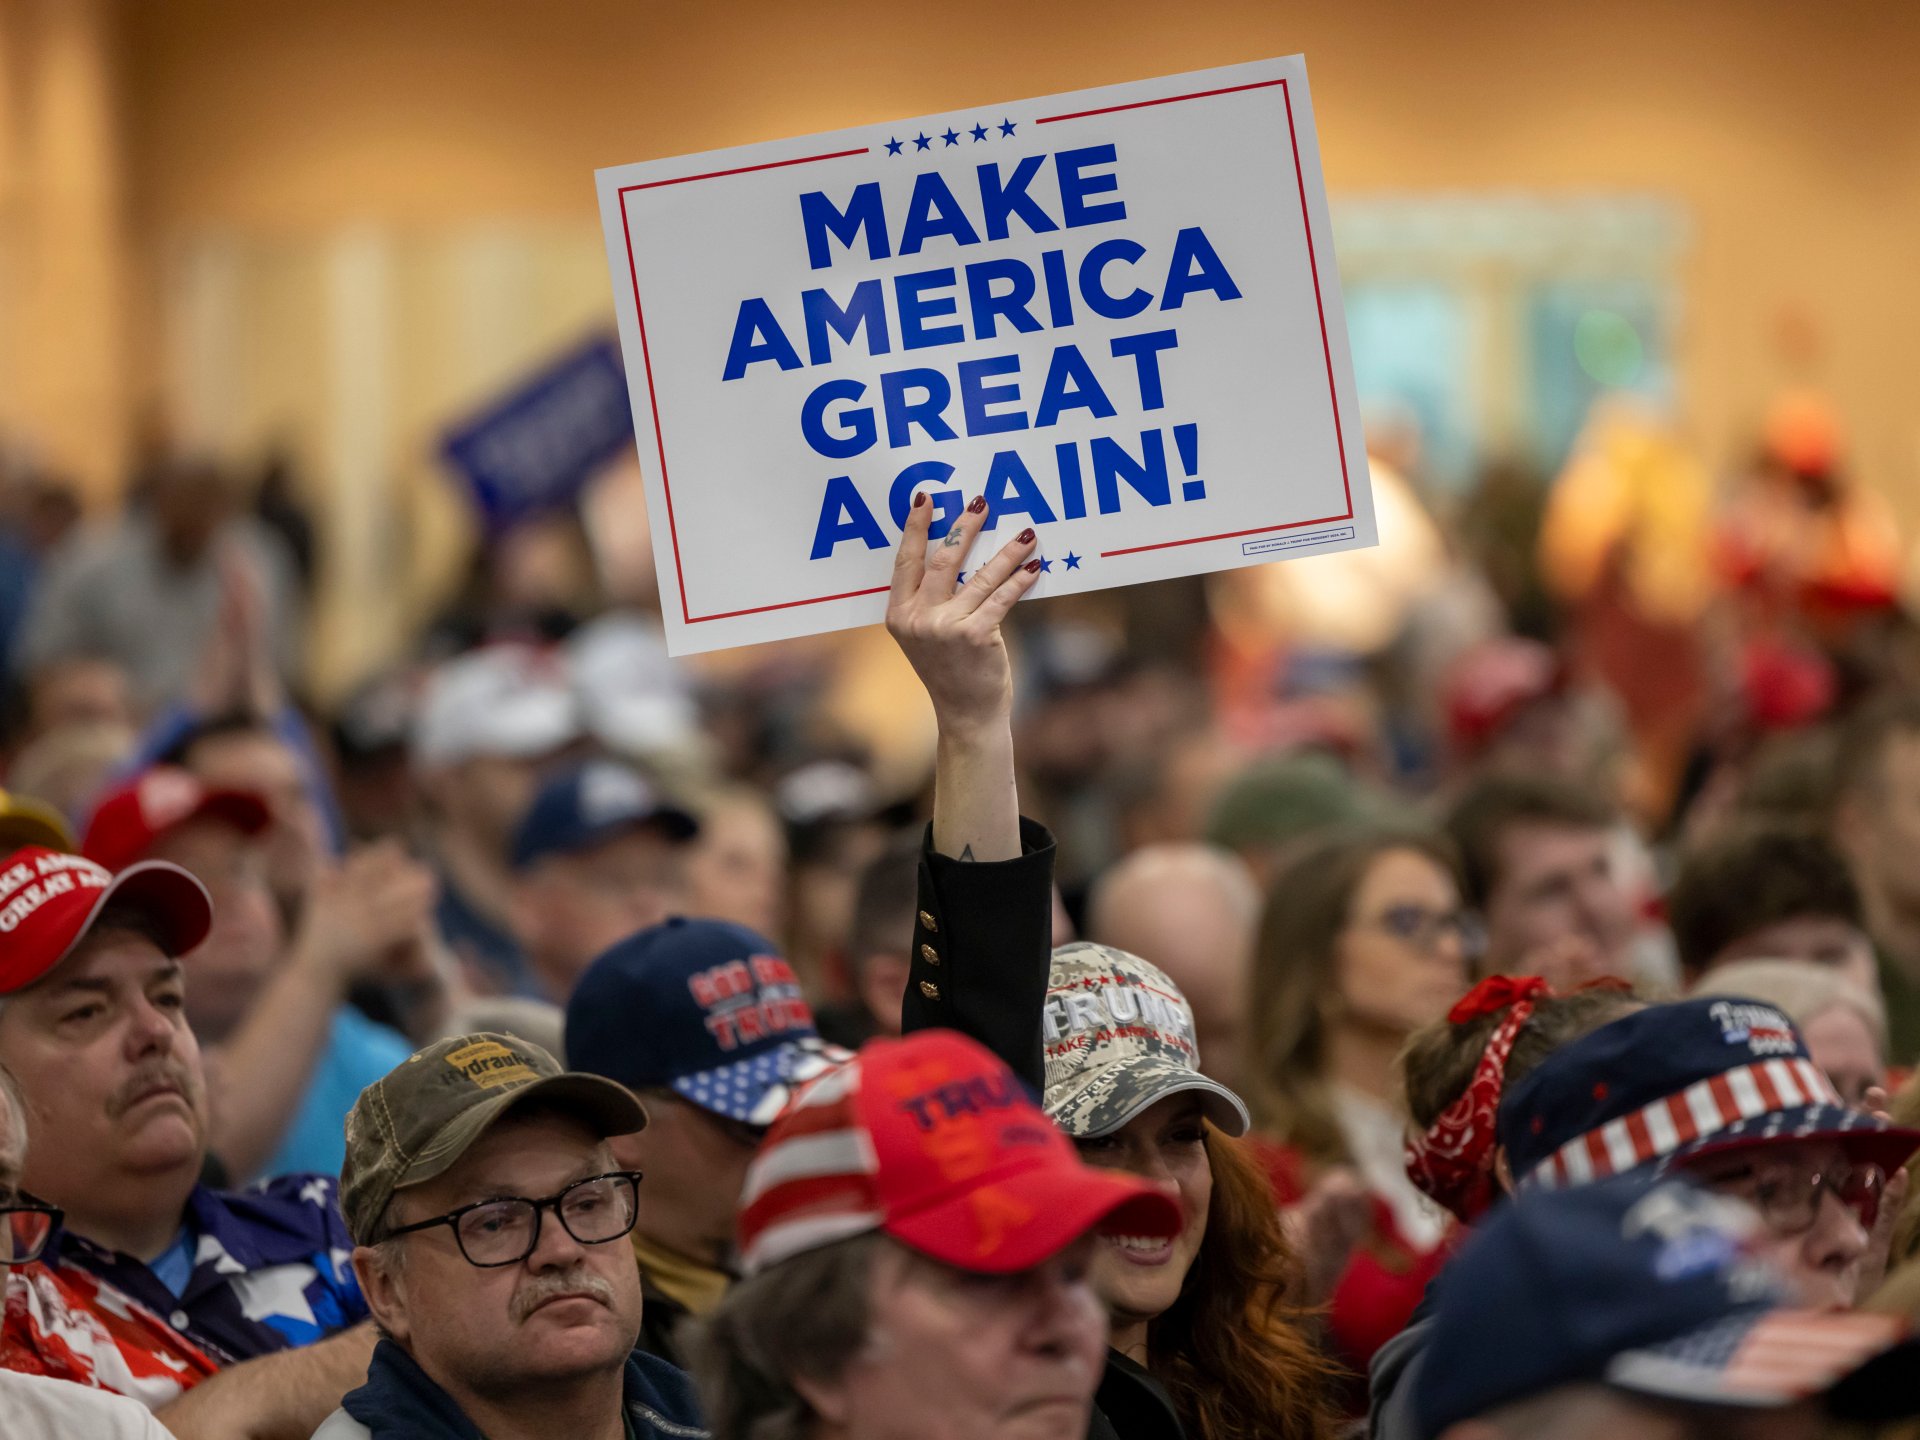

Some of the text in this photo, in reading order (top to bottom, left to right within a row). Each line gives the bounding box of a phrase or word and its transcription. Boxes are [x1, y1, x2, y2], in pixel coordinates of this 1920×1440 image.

[800, 144, 1126, 270] MAKE
[722, 227, 1242, 380] AMERICA
[801, 329, 1178, 458] GREAT
[810, 423, 1206, 560] AGAIN!
[704, 998, 814, 1051] TRUM
[1043, 986, 1188, 1042] TRUMP
[1046, 1035, 1087, 1058] TAKE
